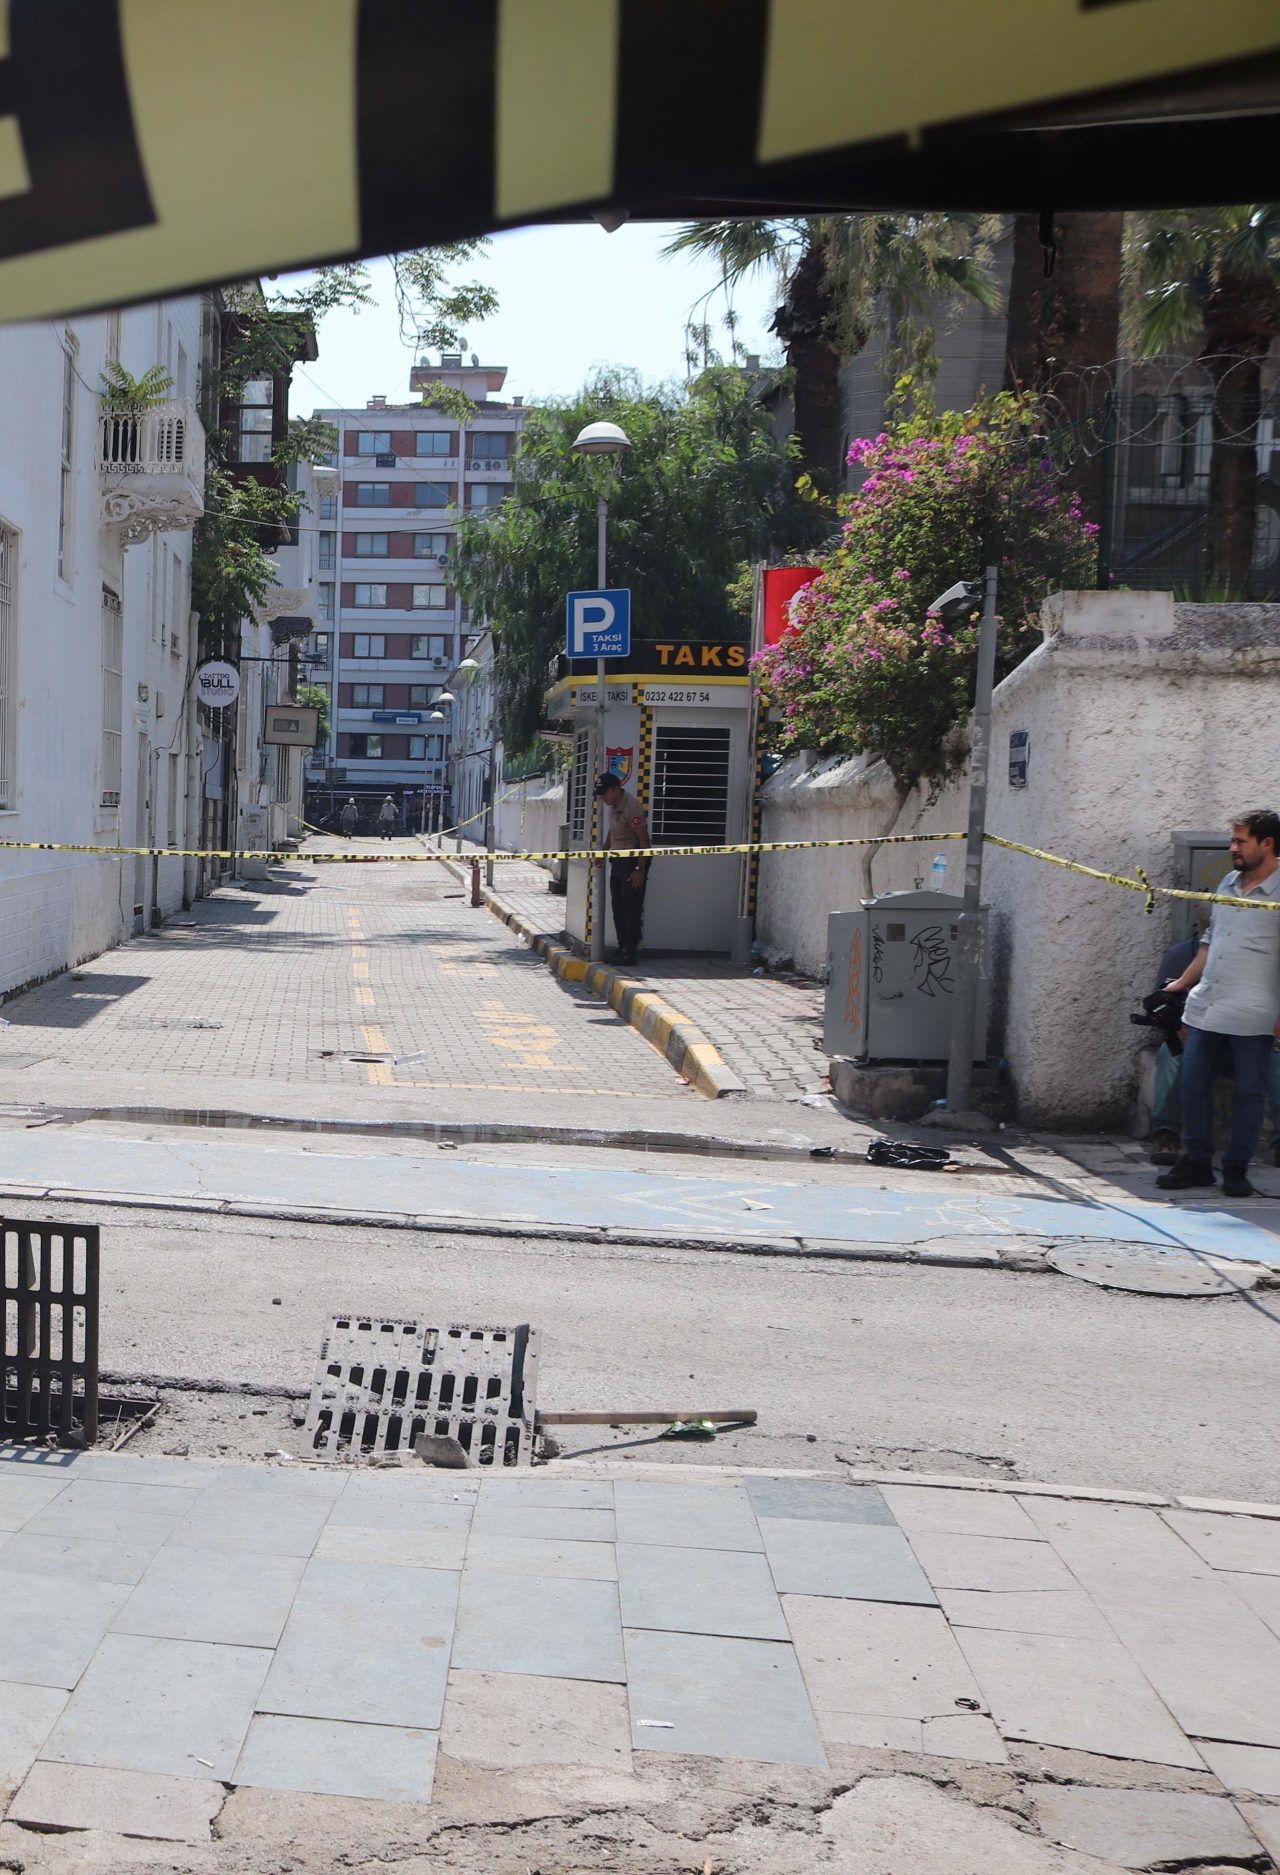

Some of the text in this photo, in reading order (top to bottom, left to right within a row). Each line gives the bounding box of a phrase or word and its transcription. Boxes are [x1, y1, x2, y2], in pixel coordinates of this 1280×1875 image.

[573, 597, 616, 653] P
[591, 632, 622, 643] TAKSİ
[592, 643, 623, 653] 3 Araç
[655, 644, 746, 667] TAKS
[200, 677, 235, 689] BULL
[607, 688, 629, 702] TAKSİ
[645, 691, 710, 702] 0232 422 67 54
